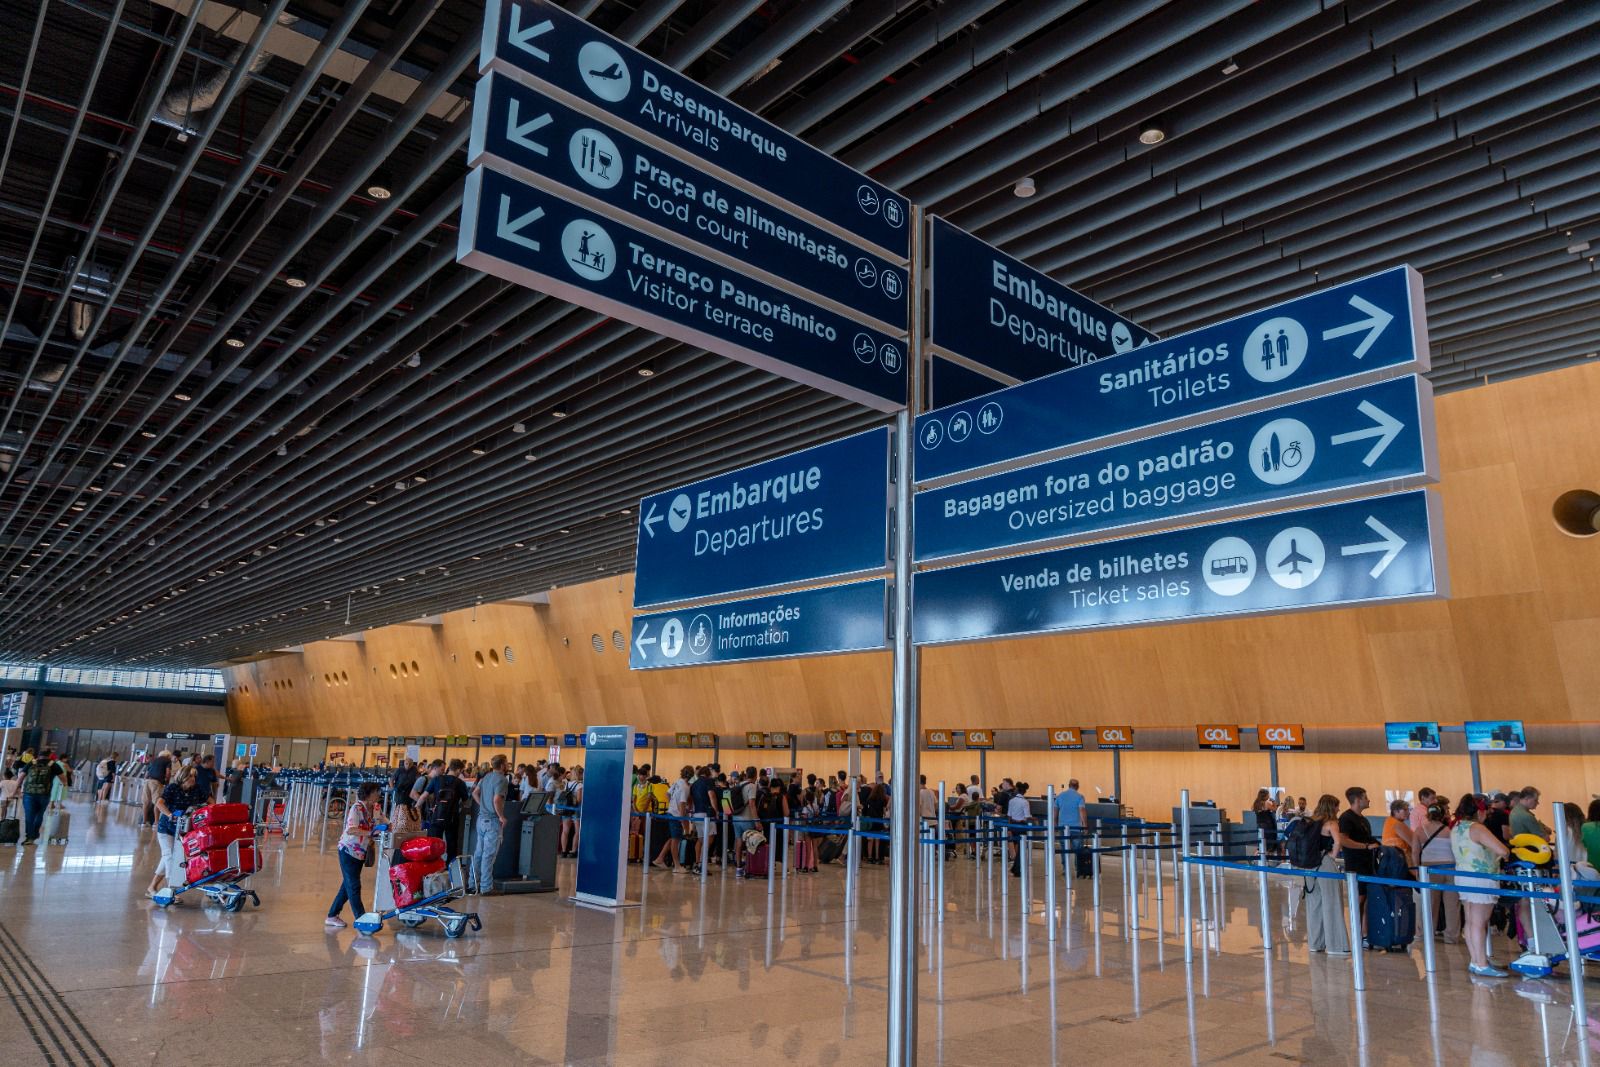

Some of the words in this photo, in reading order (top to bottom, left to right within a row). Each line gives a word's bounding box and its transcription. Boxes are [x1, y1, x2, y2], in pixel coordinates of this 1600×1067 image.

[640, 98, 720, 153] Arrivals
[642, 70, 788, 162] Desembarque
[633, 181, 689, 223] Food
[697, 211, 749, 250] court
[636, 154, 697, 202] Praça
[702, 190, 729, 215] de
[734, 202, 848, 269] alimentação
[626, 269, 698, 313] Visitor
[705, 298, 774, 343] terrace
[629, 242, 714, 295] Terraço
[721, 279, 837, 342] Panorâmico
[992, 260, 1107, 342] Embarque
[990, 297, 1097, 366] Departure
[1099, 341, 1230, 395] Sanitários
[1149, 370, 1231, 408] Toilets
[696, 466, 821, 519] Embarque
[944, 485, 1038, 520] Bagagem
[1044, 471, 1090, 498] fora
[1098, 456, 1129, 484] do
[1138, 439, 1234, 480] padrão
[1008, 486, 1114, 531] Oversized
[1122, 470, 1236, 510] baggage
[694, 508, 823, 556] Departures
[1001, 566, 1060, 593] Venda
[1066, 561, 1092, 584] de
[1098, 549, 1189, 578] bilhetes
[1069, 584, 1129, 609] Ticket
[1137, 577, 1191, 599] sales
[718, 628, 789, 650] Information
[719, 605, 801, 630] Informações
[930, 732, 948, 742] GOL
[969, 732, 988, 742] GOL
[1054, 731, 1076, 742] GOL
[1103, 729, 1126, 741] GOL
[1204, 728, 1232, 741] GOL
[1265, 728, 1296, 741] GOL
